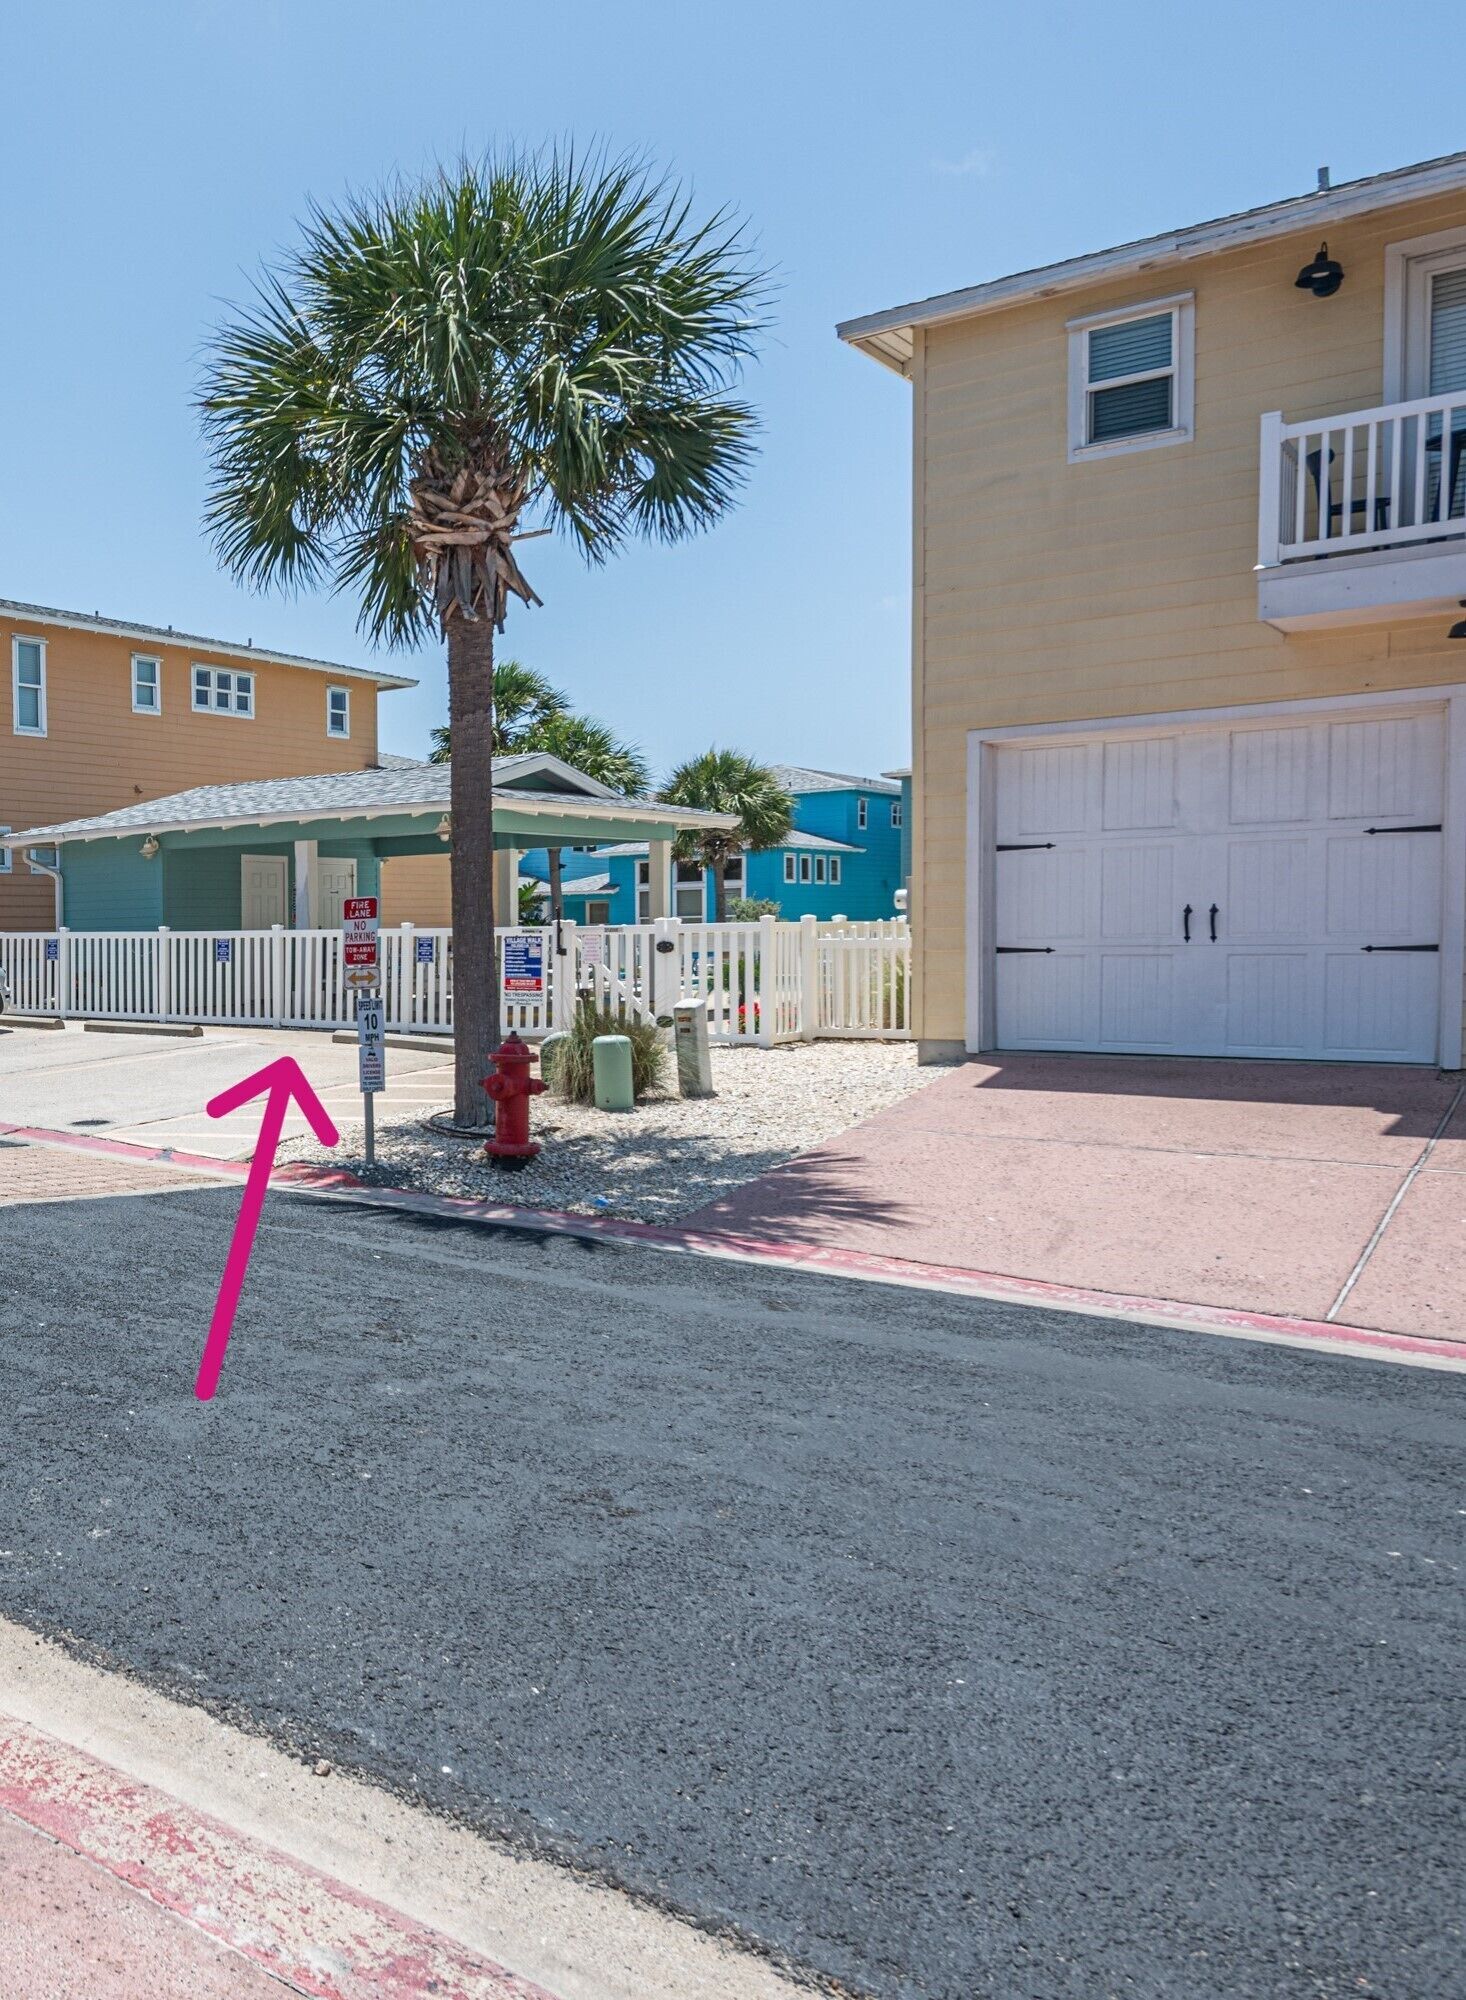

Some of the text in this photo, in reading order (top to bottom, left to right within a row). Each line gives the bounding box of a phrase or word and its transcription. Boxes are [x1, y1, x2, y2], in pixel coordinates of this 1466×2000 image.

[351, 901, 370, 910] FIRE
[349, 909, 371, 918] LANE
[354, 920, 367, 931] NO
[345, 932, 376, 942] PARKING
[346, 946, 375, 954] TOW-AWAY
[353, 953, 368, 961] ZONE
[358, 1000, 371, 1011] SPEED
[364, 1013, 378, 1030] 10
[365, 1033, 380, 1041] MPH
